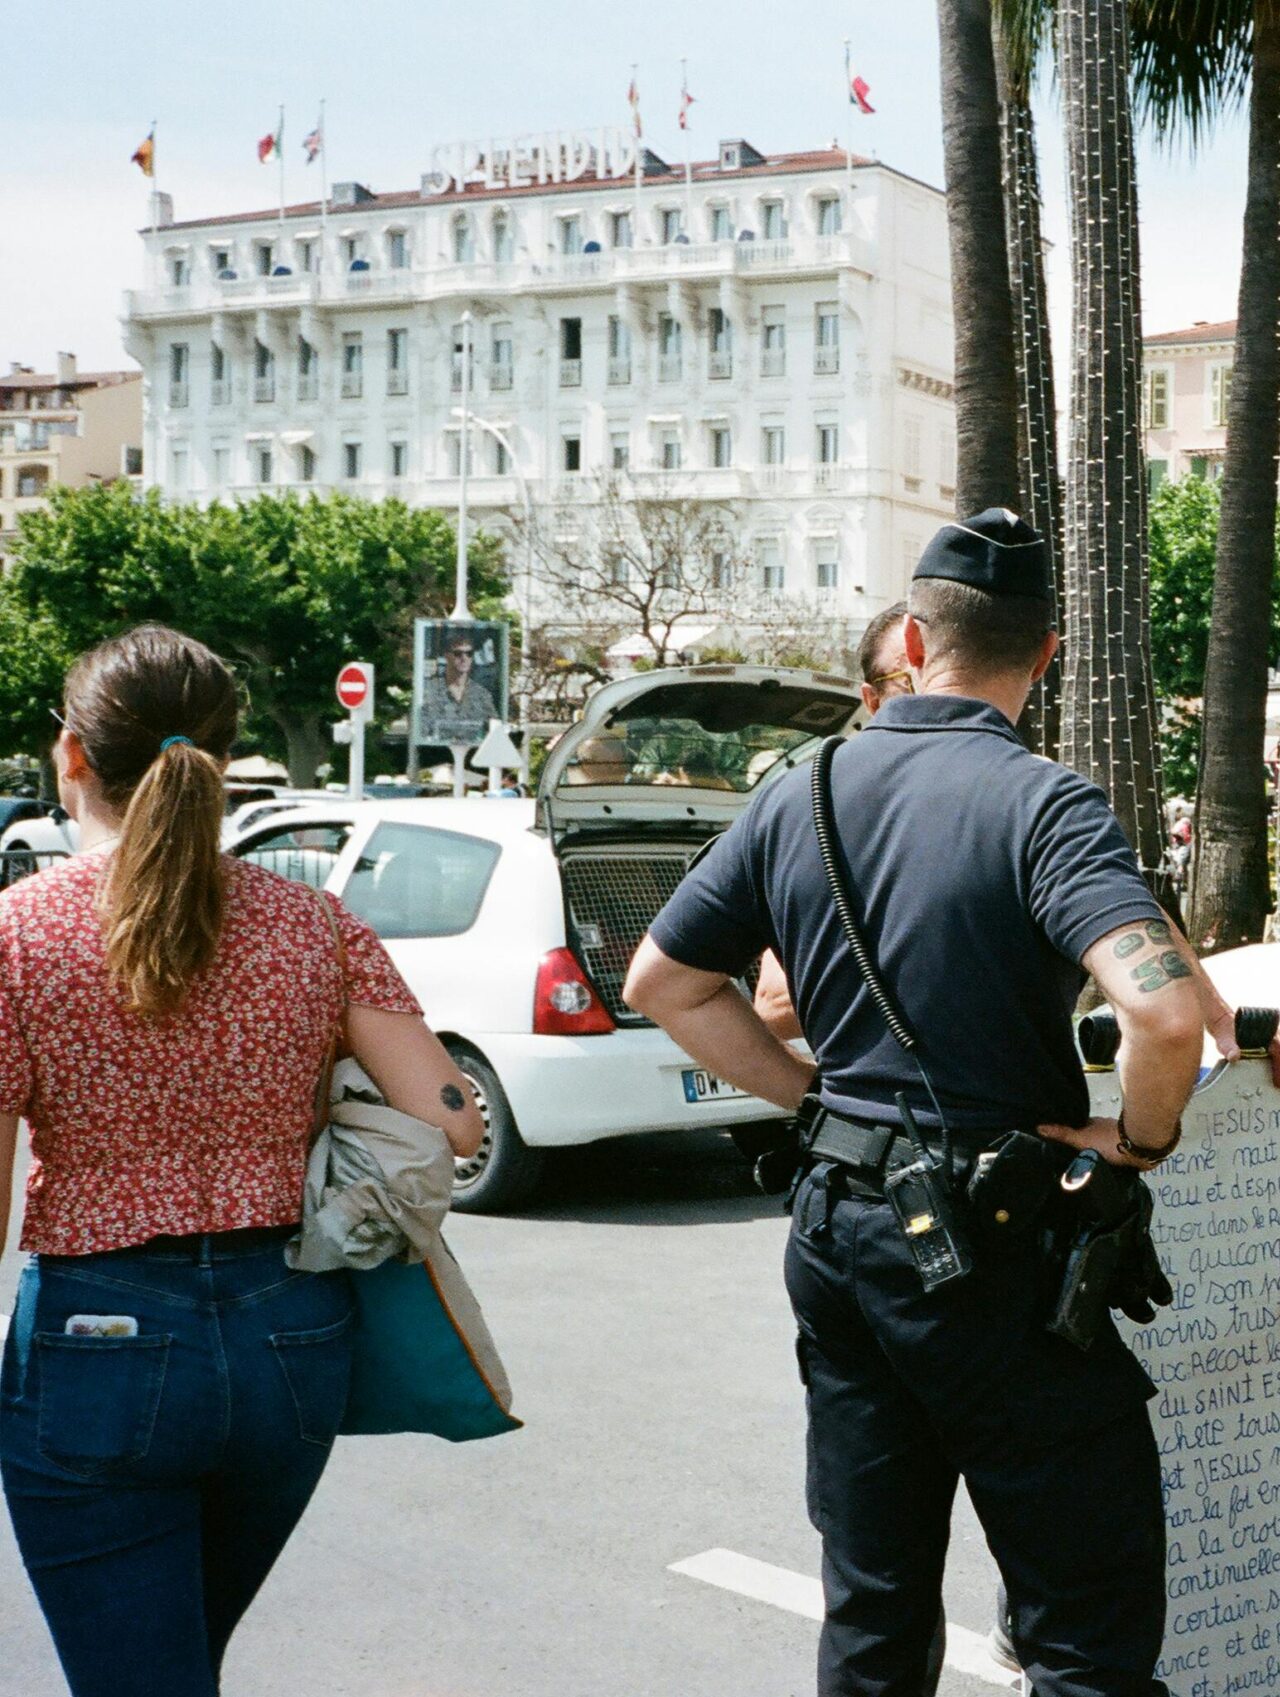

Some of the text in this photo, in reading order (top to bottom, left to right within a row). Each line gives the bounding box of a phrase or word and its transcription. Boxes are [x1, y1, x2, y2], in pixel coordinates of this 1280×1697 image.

[1196, 1107, 1265, 1151] JESUS
[1206, 1175, 1227, 1202] et
[1208, 1211, 1249, 1237] dans
[1205, 1279, 1254, 1304] son
[1132, 1315, 1217, 1350] moins
[1159, 1389, 1190, 1418] du
[1234, 1410, 1280, 1441] tous
[1194, 1449, 1261, 1497] JESUS
[1199, 1497, 1223, 1521] la
[1228, 1485, 1253, 1529] foi
[1197, 1529, 1225, 1560] la
[1225, 1631, 1246, 1658] et
[1251, 1623, 1271, 1651] de
